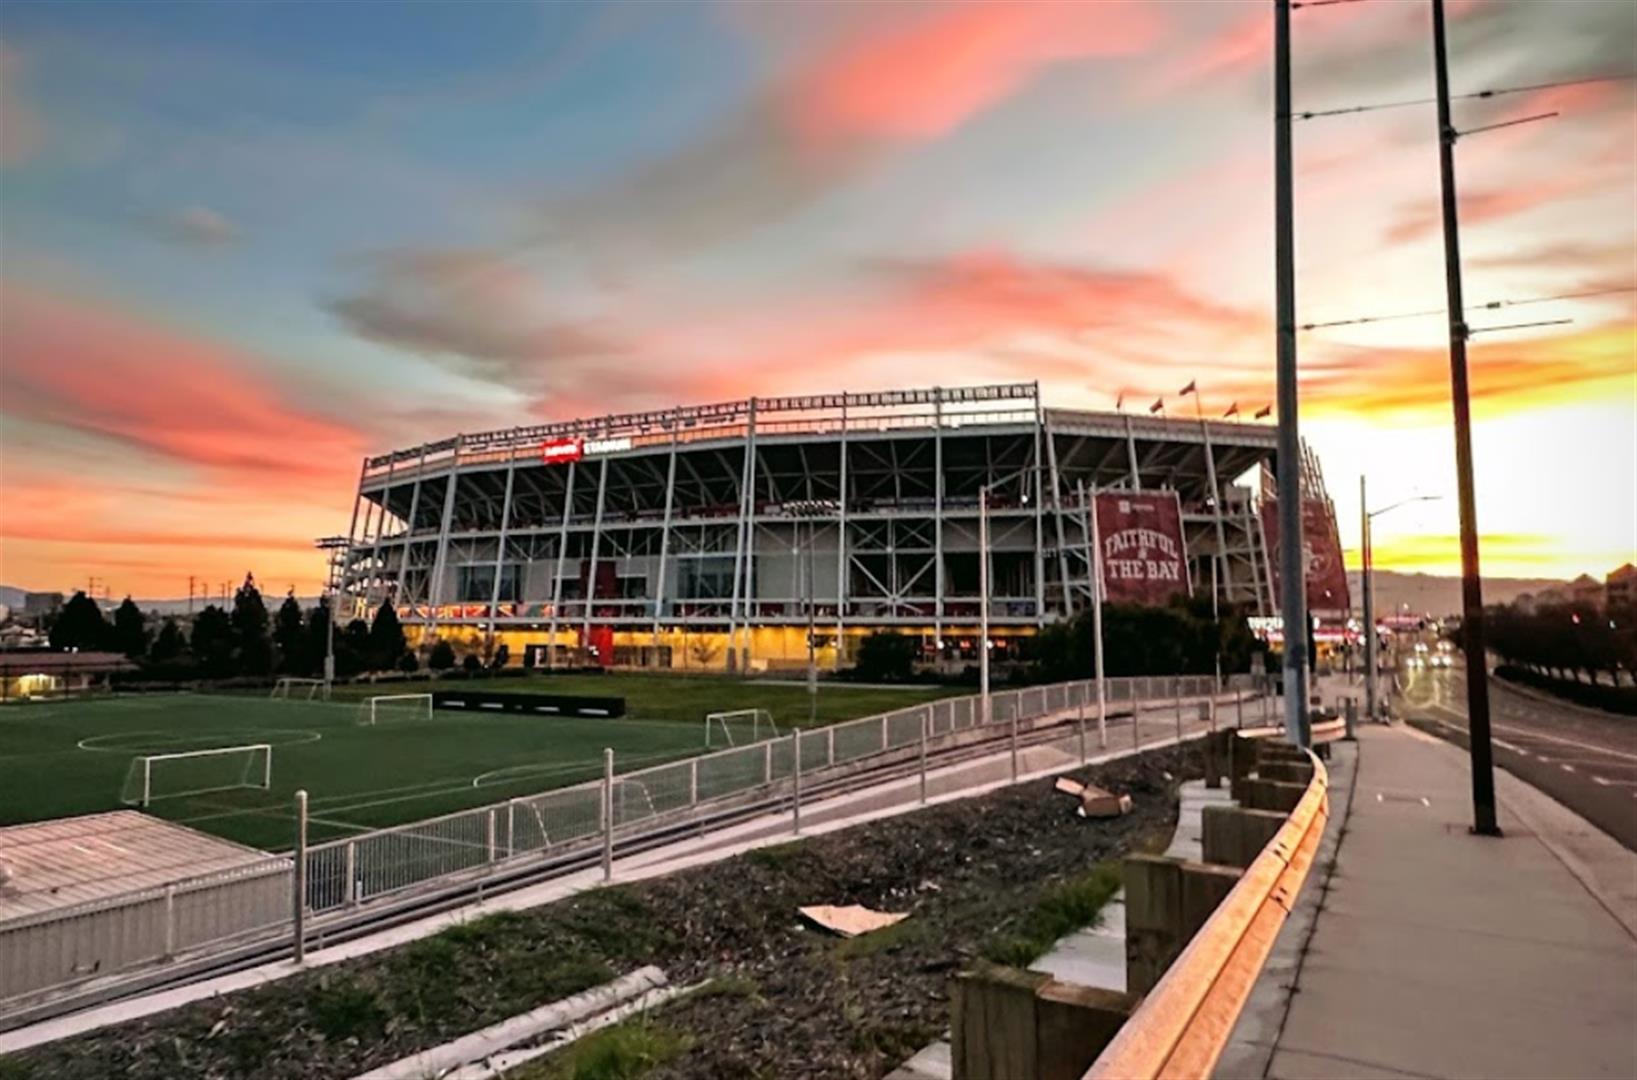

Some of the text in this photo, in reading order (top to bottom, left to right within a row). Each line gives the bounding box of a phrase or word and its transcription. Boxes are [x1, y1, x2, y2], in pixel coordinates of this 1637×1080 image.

[1105, 529, 1179, 559] FAITHFUL
[1106, 560, 1179, 579] THE BAY
